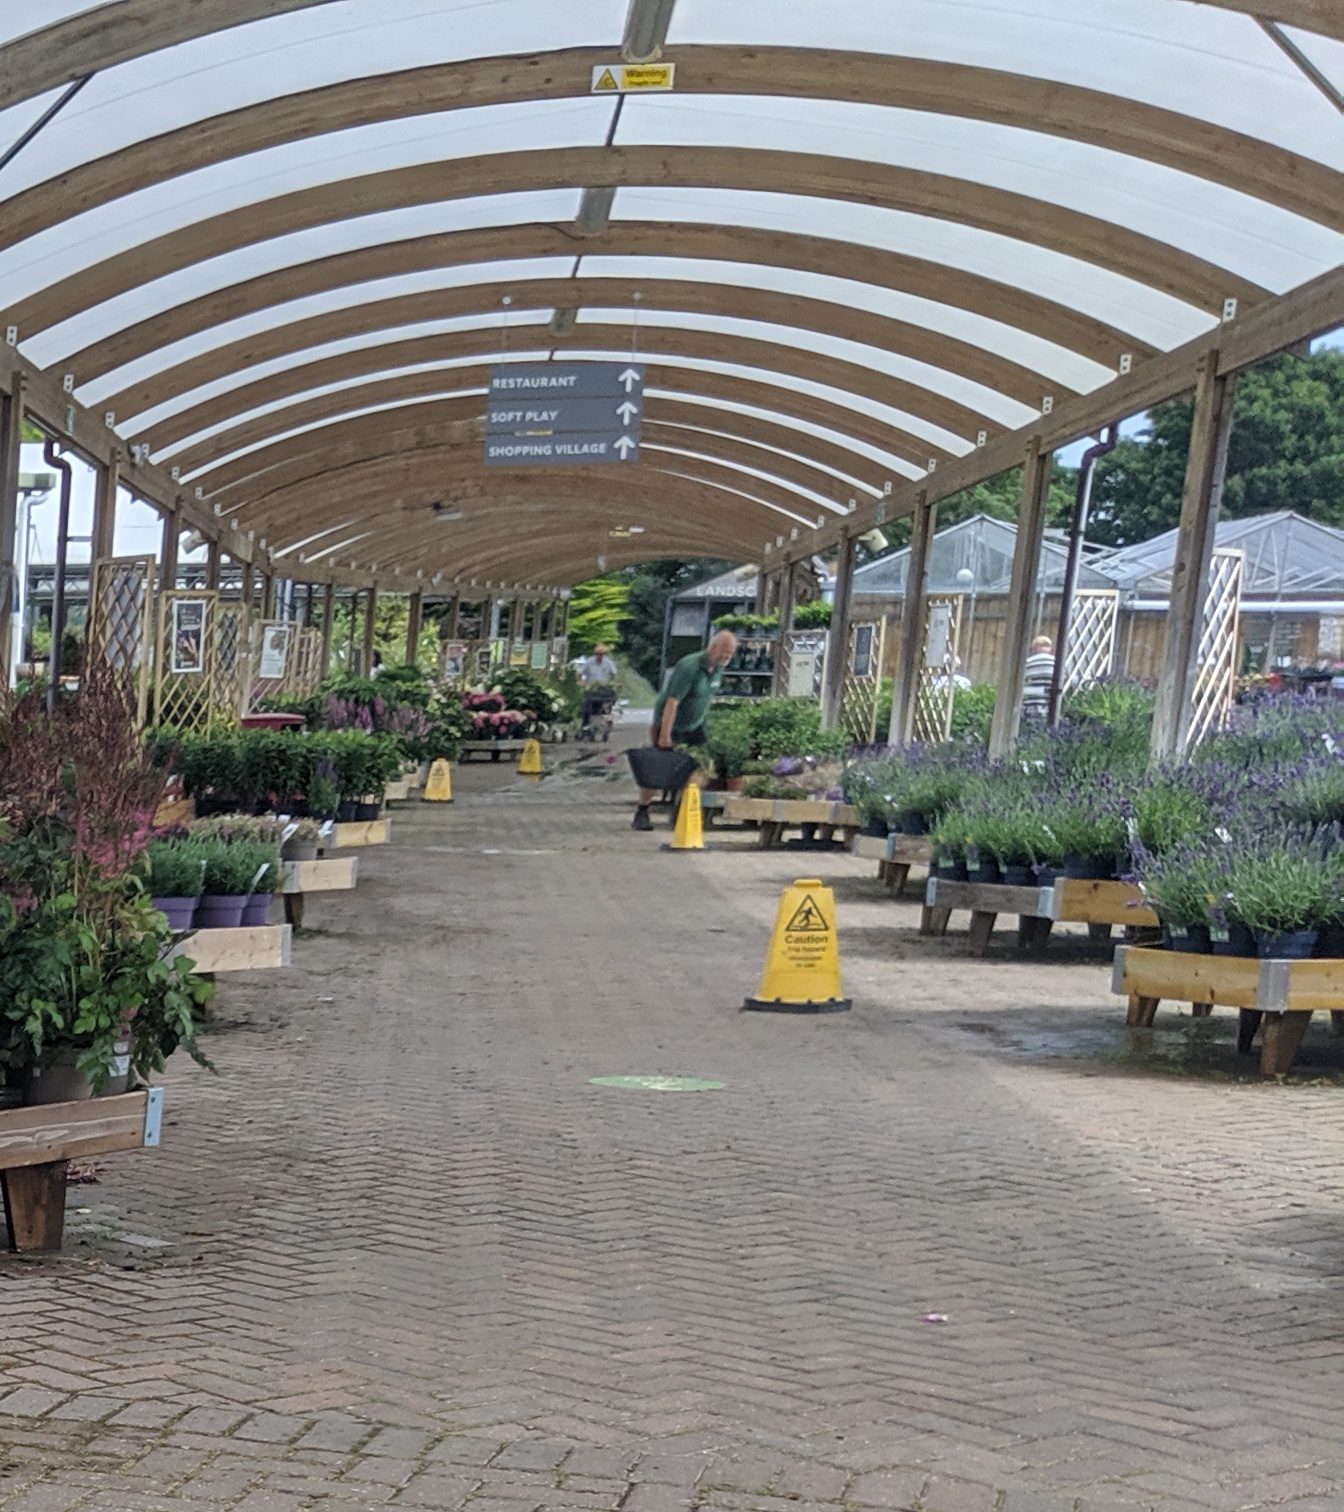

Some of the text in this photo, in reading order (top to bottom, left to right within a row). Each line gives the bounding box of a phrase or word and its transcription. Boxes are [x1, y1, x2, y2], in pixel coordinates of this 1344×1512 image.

[626, 68, 668, 80] Warning
[491, 375, 578, 390] RESTAURANT
[490, 409, 559, 424] SOFT PLAY
[488, 442, 607, 458] SHOPPING VILLAGE
[695, 585, 757, 598] LANDSC
[784, 934, 828, 945] Caution
